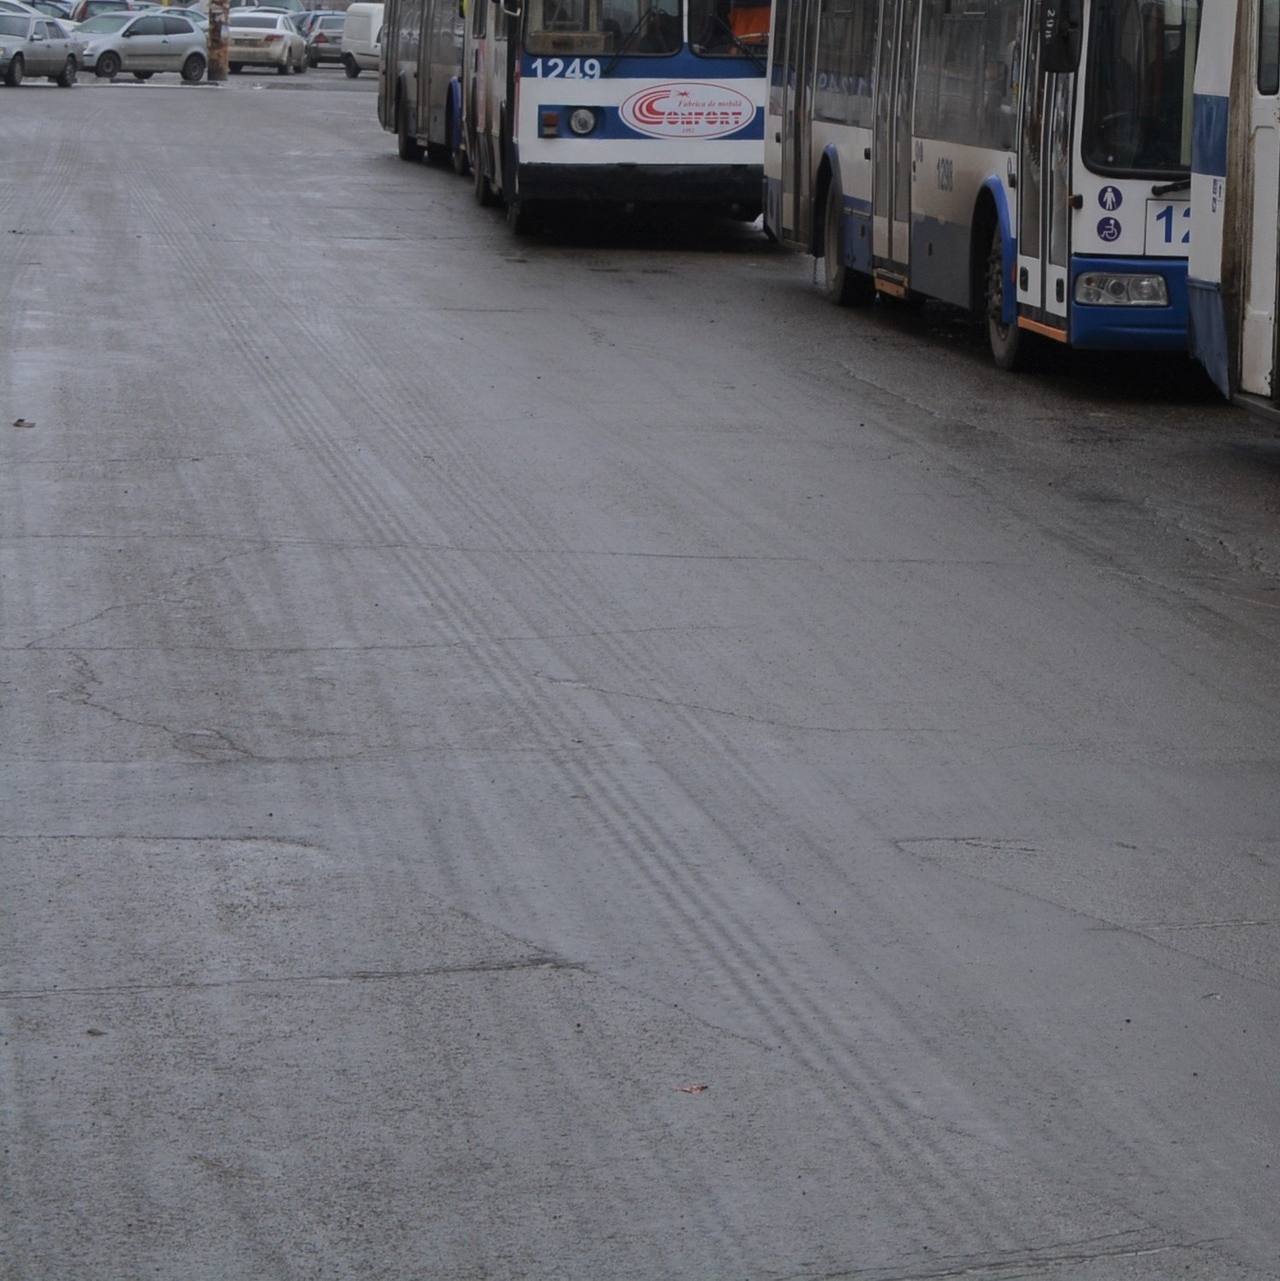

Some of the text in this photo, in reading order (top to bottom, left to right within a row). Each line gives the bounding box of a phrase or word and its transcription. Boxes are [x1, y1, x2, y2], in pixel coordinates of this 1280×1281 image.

[531, 57, 601, 80] 1249
[632, 89, 743, 125] CONFORT
[707, 100, 717, 108] de
